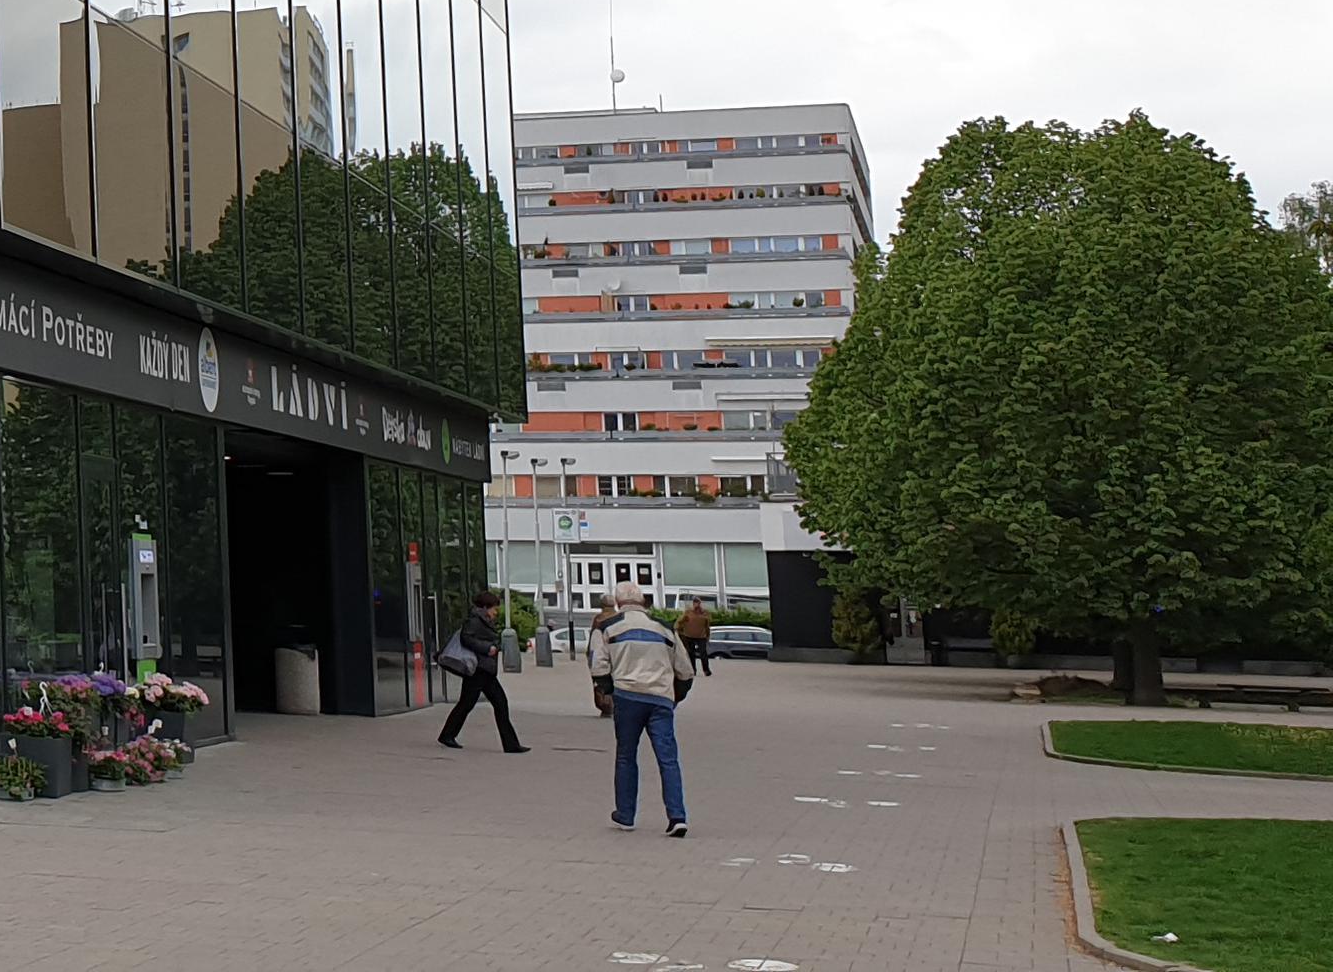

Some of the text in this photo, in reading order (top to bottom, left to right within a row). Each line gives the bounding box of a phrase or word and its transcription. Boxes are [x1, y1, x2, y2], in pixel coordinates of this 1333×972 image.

[139, 330, 191, 383] KAŽDÝ DEN
[271, 364, 348, 430] LÁDVÍ
